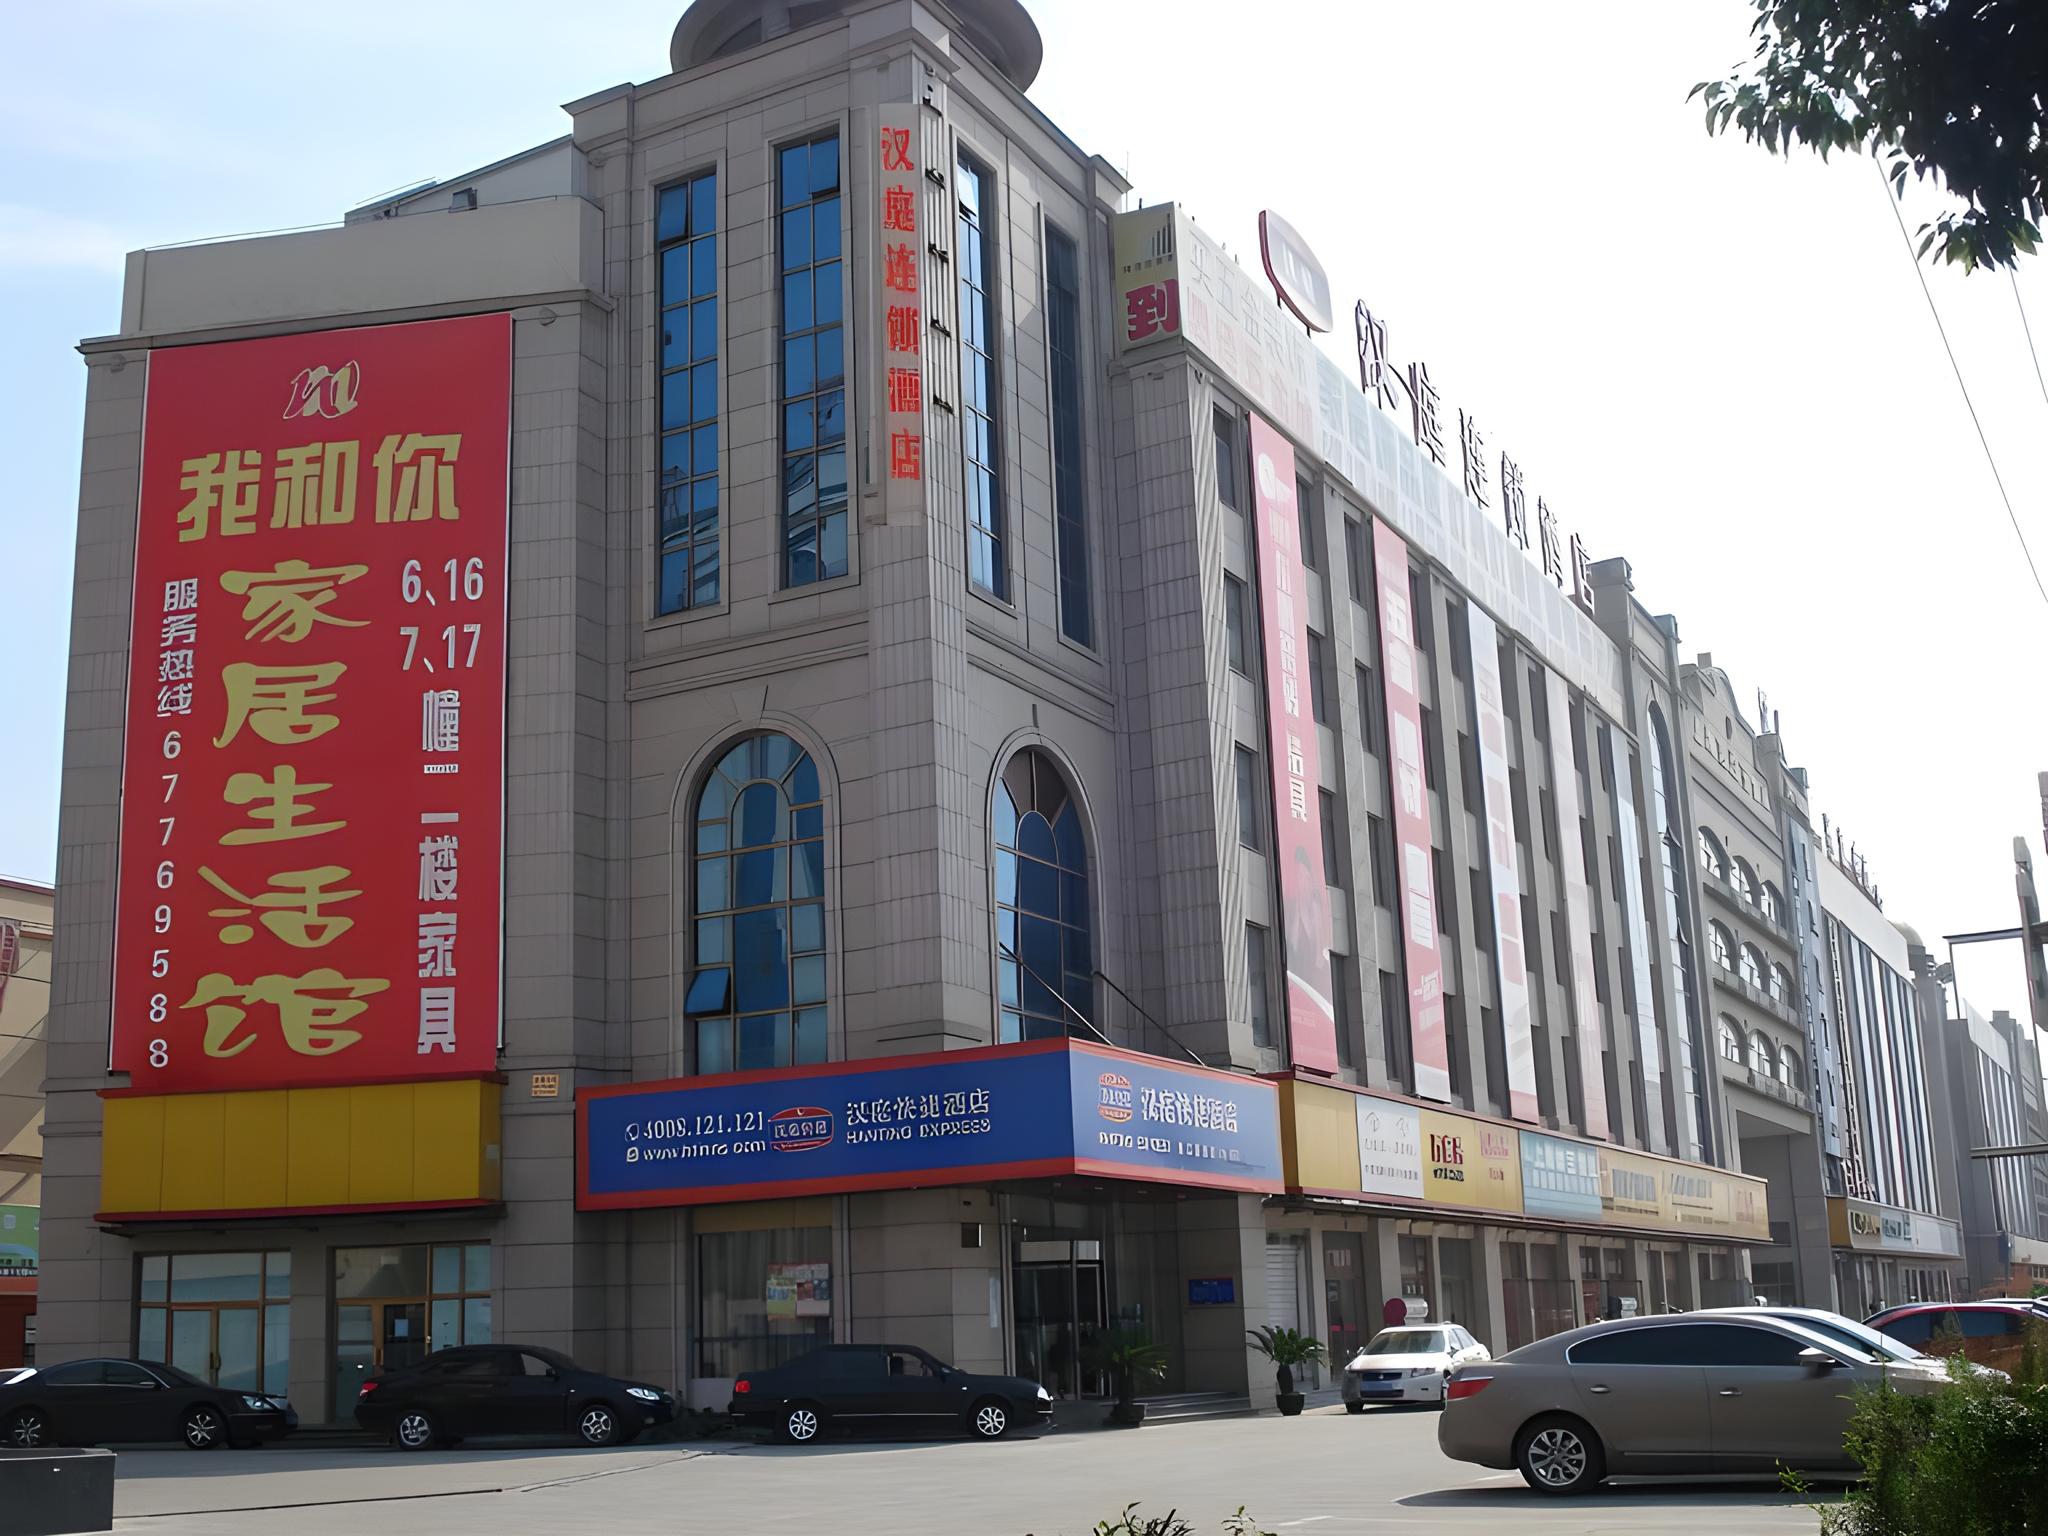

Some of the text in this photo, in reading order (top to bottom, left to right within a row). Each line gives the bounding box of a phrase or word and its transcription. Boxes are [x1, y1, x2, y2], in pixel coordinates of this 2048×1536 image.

[177, 433, 463, 543] 我和你
[179, 559, 392, 1057] 家居生活馆
